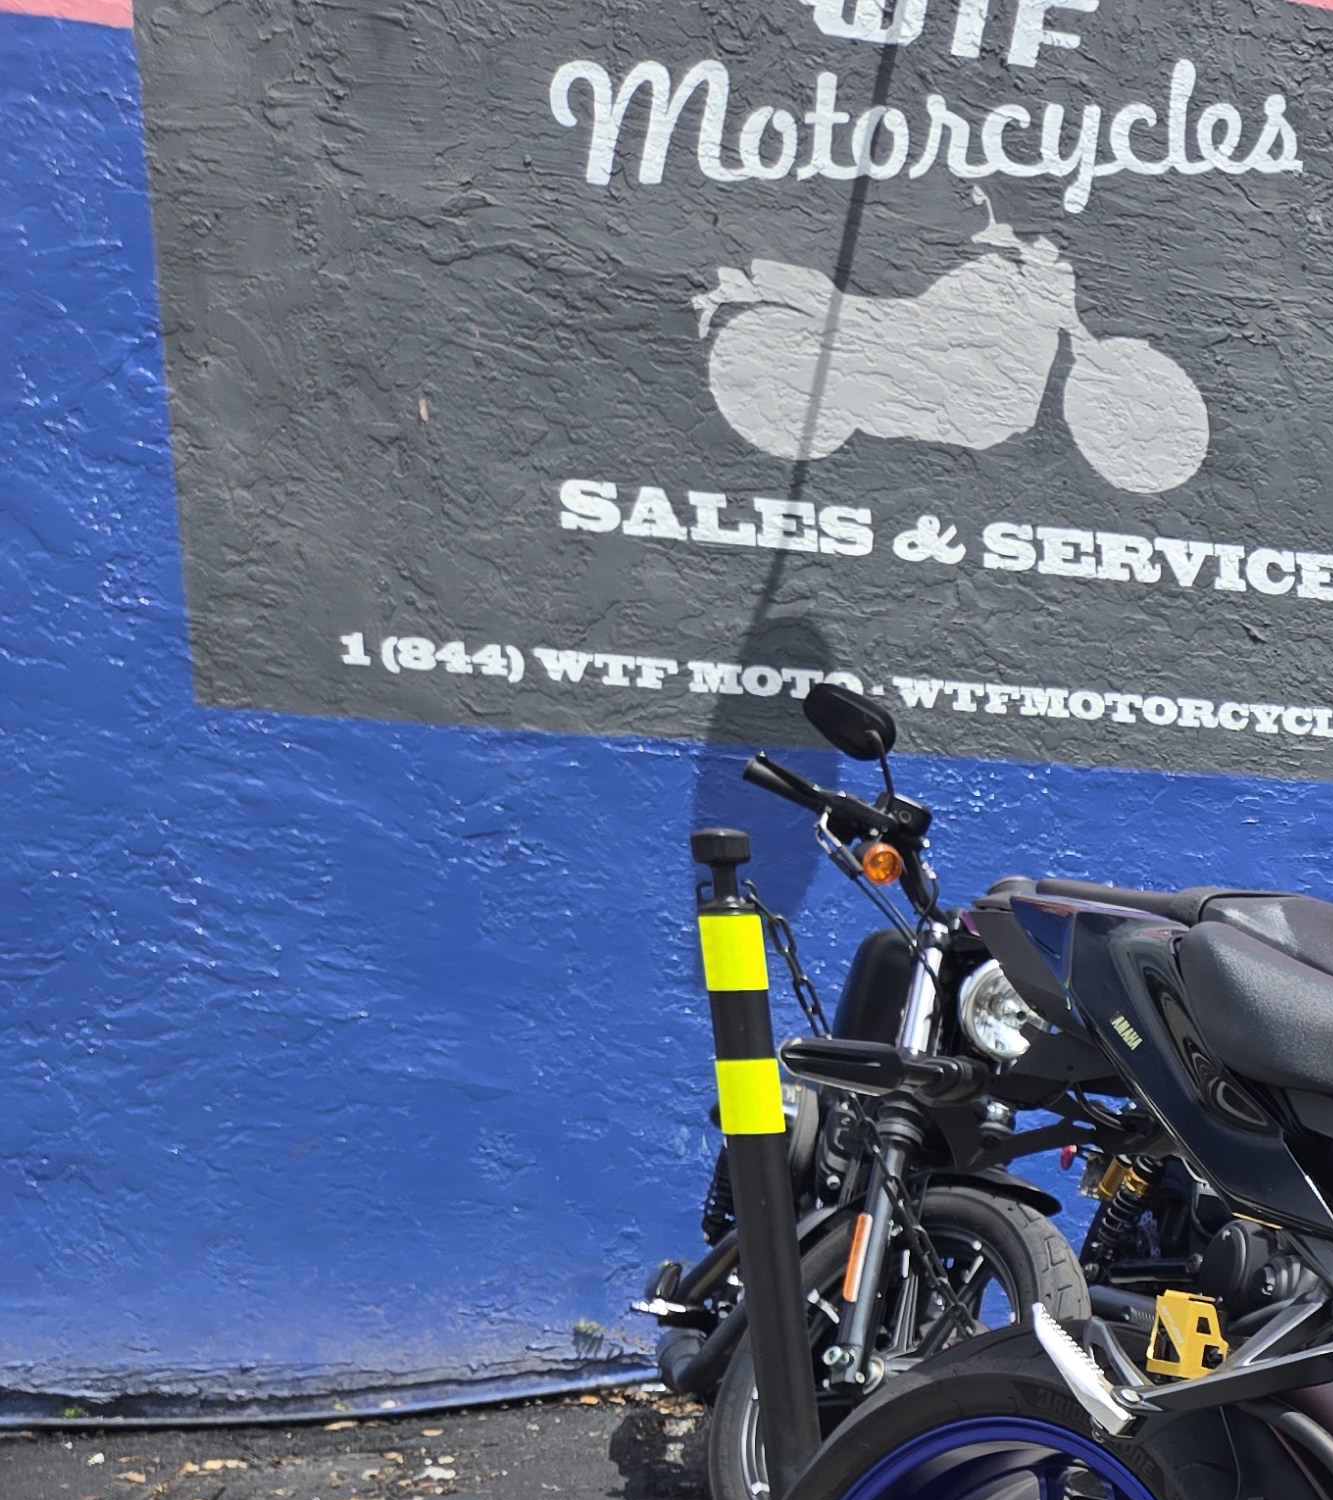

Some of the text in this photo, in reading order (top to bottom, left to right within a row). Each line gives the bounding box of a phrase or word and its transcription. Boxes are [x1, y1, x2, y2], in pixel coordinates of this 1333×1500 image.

[549, 59, 1304, 213] Motorcycles
[558, 478, 874, 556] SALES
[892, 514, 967, 565] &
[340, 632, 371, 666] 1
[381, 636, 525, 684] (844)
[533, 648, 679, 689] WTF
[1111, 1014, 1143, 1051] AMAHA
